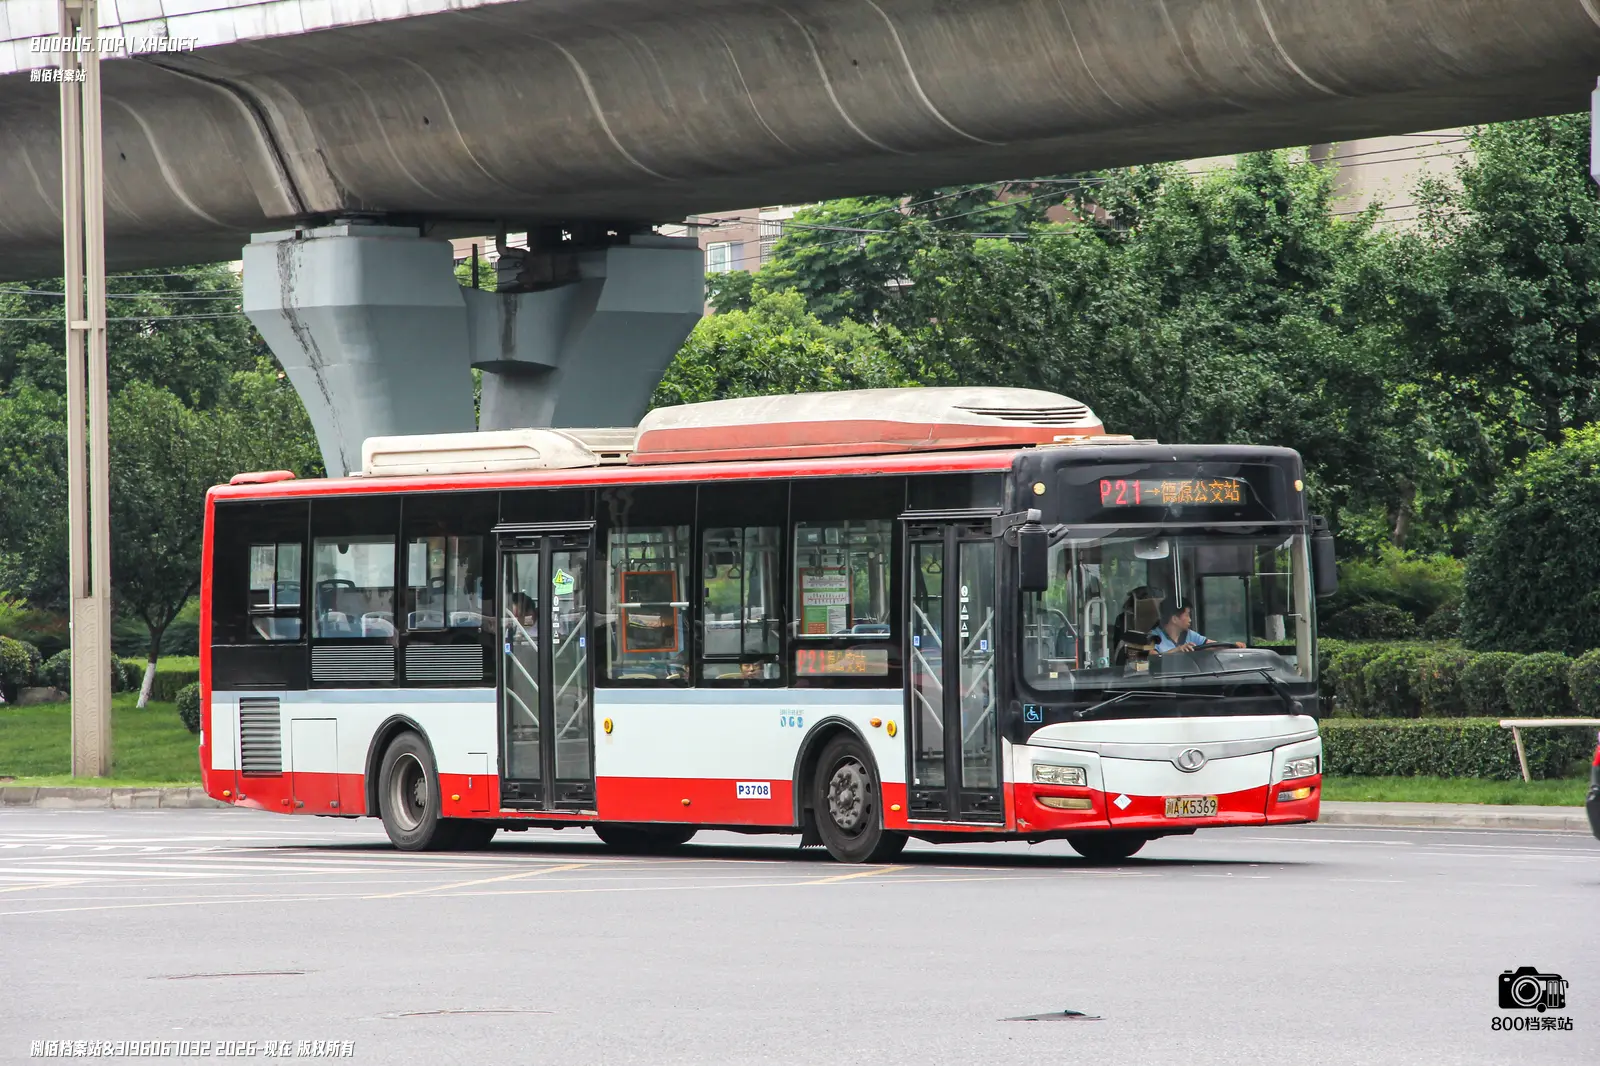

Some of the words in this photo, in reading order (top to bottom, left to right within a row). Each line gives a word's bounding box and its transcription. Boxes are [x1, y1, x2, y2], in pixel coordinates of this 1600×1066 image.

[1100, 479, 1141, 505] P21
[1161, 479, 1240, 504] 德源公交站
[797, 649, 825, 673] P21
[738, 785, 769, 796] P3708
